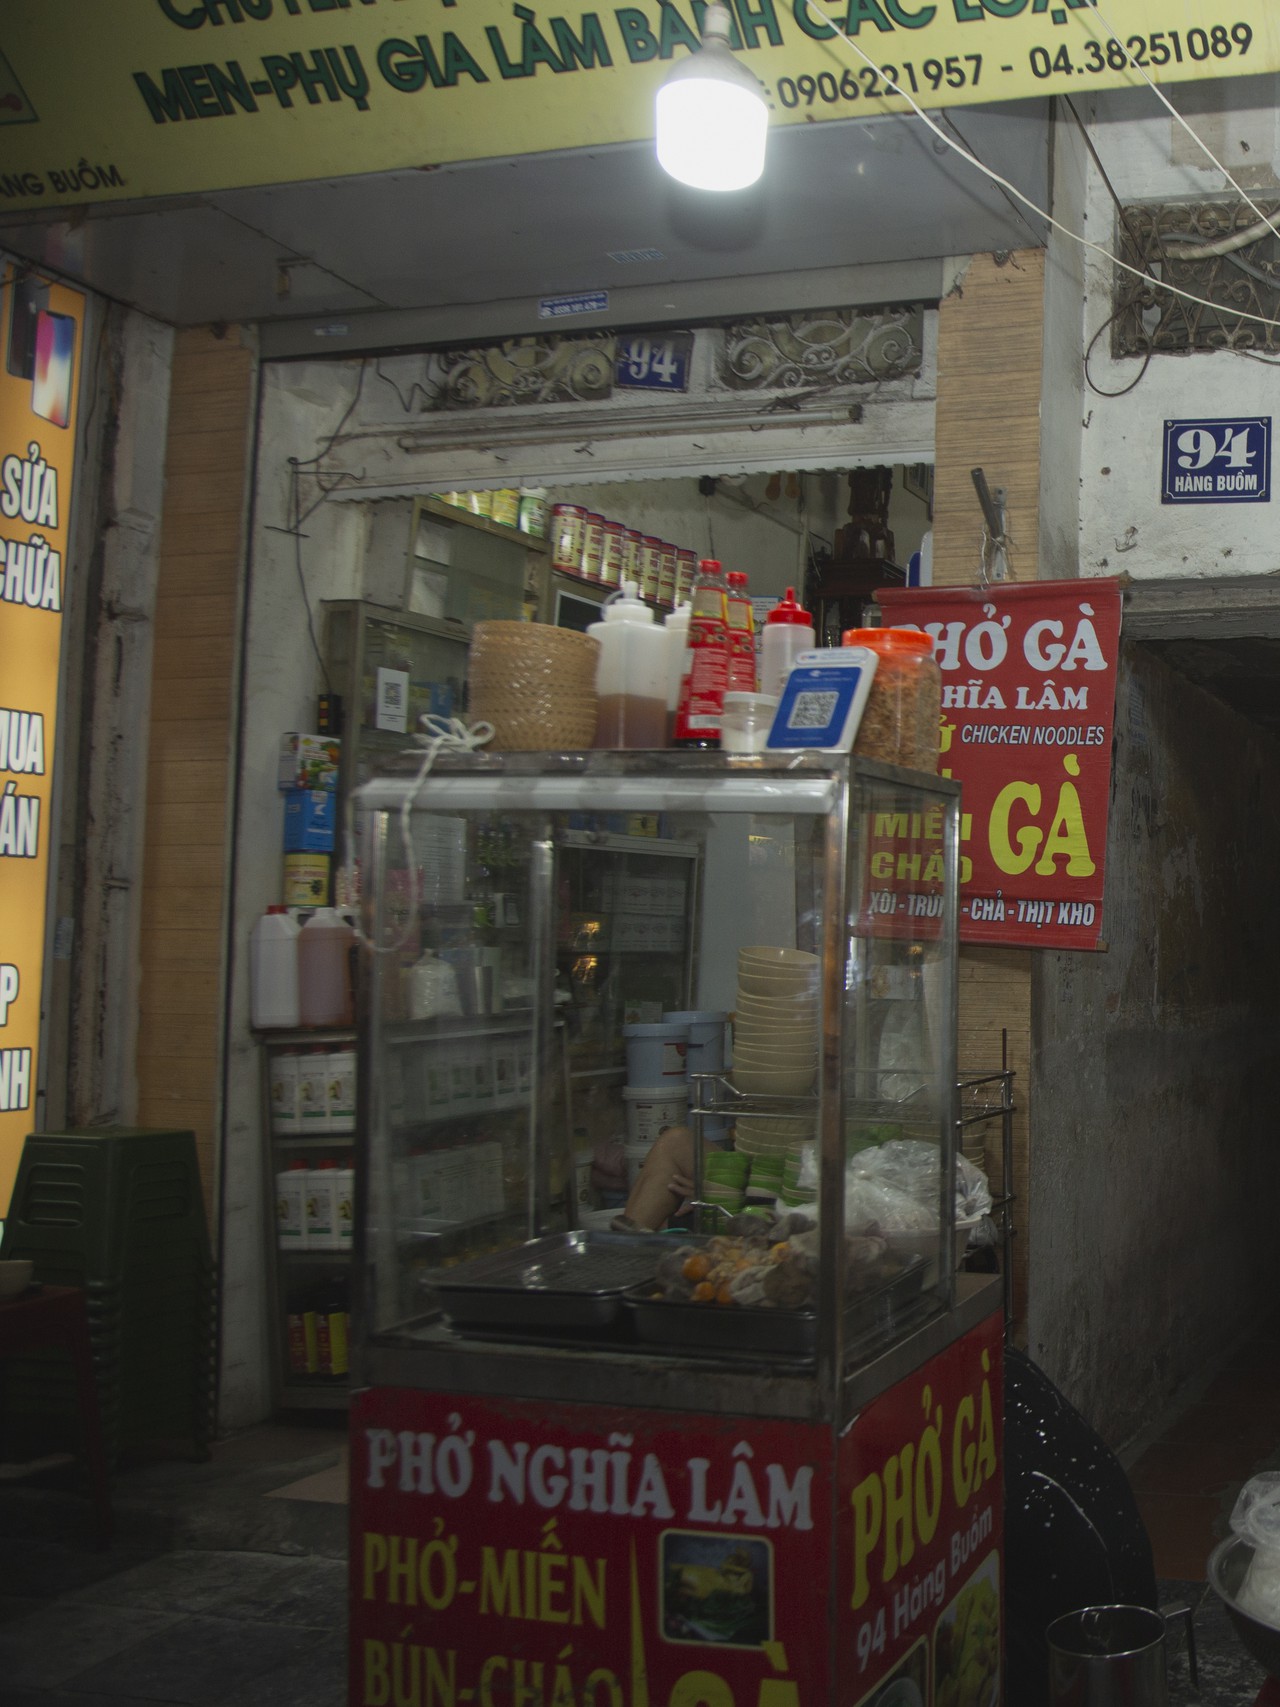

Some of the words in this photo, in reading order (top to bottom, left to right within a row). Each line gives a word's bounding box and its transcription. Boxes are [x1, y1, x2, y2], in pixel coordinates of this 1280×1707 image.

[377, 32, 489, 93] GIA
[485, 2, 613, 79] LÀM
[1029, 22, 1254, 79] 04.38251089
[629, 337, 678, 383] 94
[1177, 427, 1257, 469] 94
[0, 441, 58, 529] SỬA
[1175, 473, 1213, 492] HÀNG
[1217, 469, 1258, 491] BUỒM
[1023, 602, 1109, 672] GÀ
[1015, 679, 1089, 710] LÂM
[961, 724, 1029, 745] CHICKEN
[1033, 726, 1105, 746] NOODLES
[988, 753, 1096, 878] GÀ
[971, 890, 1006, 922] CHẢ
[1017, 900, 1057, 928] THỊT
[1057, 902, 1095, 927] KHO
[364, 1412, 476, 1498] PHỞ
[488, 1432, 675, 1520] NGHĨA
[687, 1440, 815, 1531] LÂM
[851, 1384, 943, 1611] PHỞ
[952, 1348, 997, 1508] GÀ
[856, 1606, 886, 1674] 94
[893, 1558, 946, 1640] Hàng
